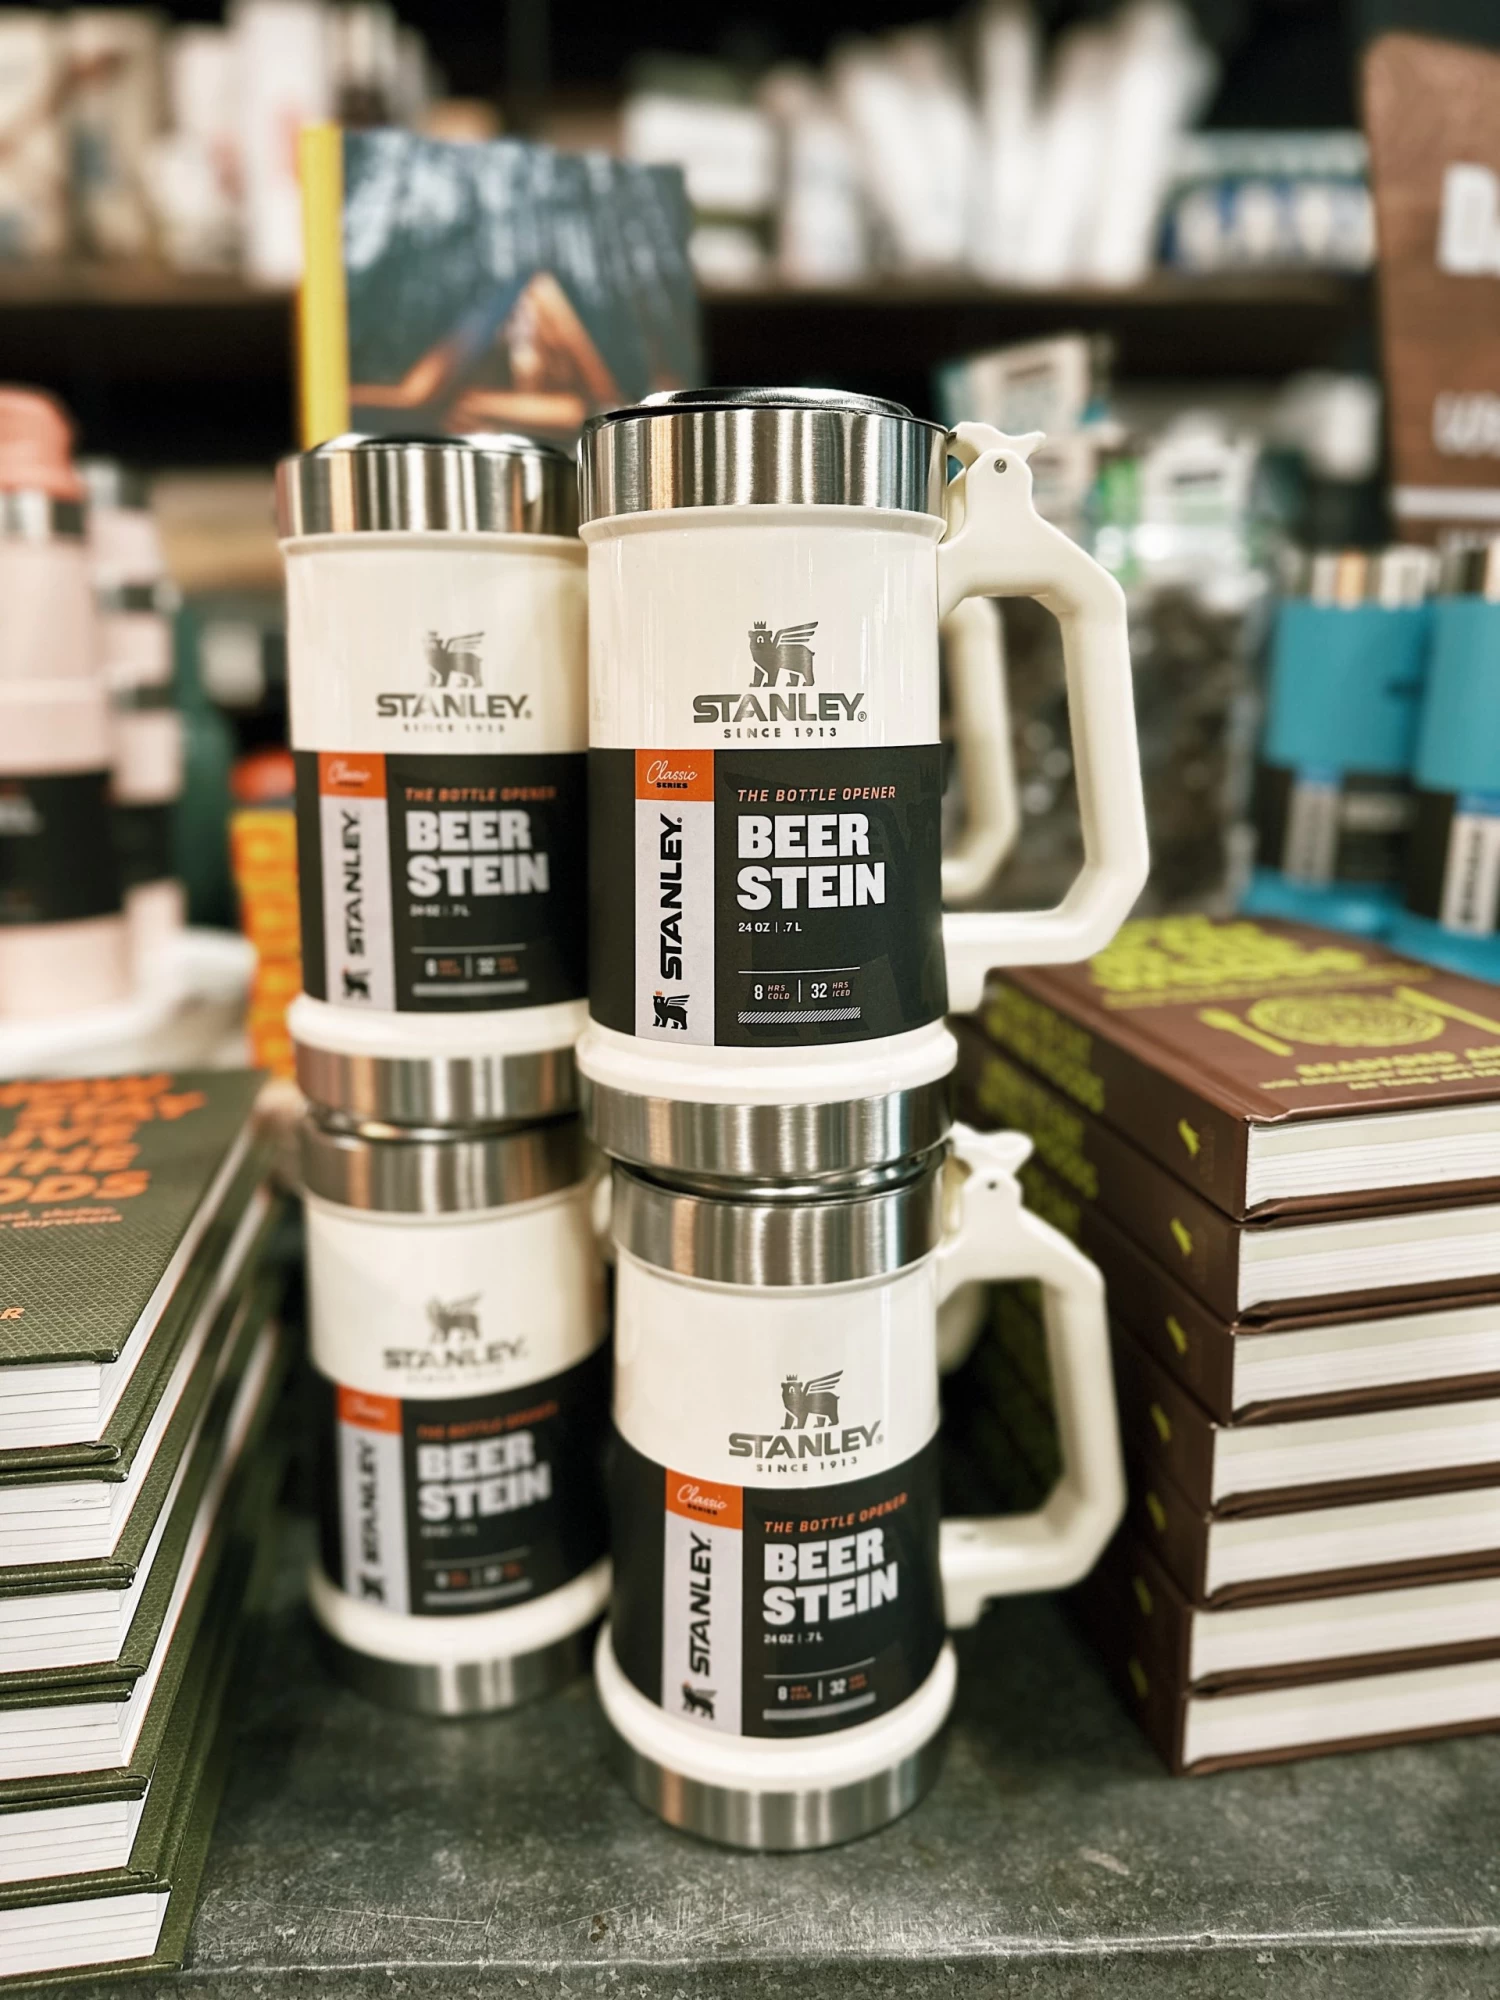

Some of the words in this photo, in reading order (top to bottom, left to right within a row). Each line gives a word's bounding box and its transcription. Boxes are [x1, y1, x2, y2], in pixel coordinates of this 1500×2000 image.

[376, 694, 529, 719] STANLEY
[724, 727, 783, 739] SINCE
[794, 726, 838, 739] 1913
[646, 760, 698, 783] Classic
[405, 787, 434, 802] THE
[737, 788, 769, 803] THE
[775, 787, 837, 802] BOTTLE
[842, 786, 896, 801] OPENER
[405, 810, 532, 852] BEER
[737, 813, 870, 860] BEER
[342, 811, 365, 957] STANLEY
[406, 852, 550, 898] STEIN
[736, 861, 886, 911] STEIN
[737, 921, 753, 934] 24
[754, 921, 771, 934] OZ
[782, 921, 793, 933] .7
[794, 920, 803, 933] L
[753, 983, 764, 1001] 8
[810, 982, 828, 999] 32
[767, 984, 786, 993] HRS
[832, 980, 849, 989] HRS
[767, 992, 790, 1001] COLD
[832, 988, 851, 997] ICED
[416, 1431, 535, 1483] BEER
[756, 1463, 809, 1474] SINCE
[819, 1456, 859, 1471] 1913
[418, 1462, 552, 1521] STEIN
[764, 1520, 793, 1534] THE
[799, 1513, 855, 1534] BOTTLE
[763, 1527, 885, 1583] BEER
[762, 1562, 898, 1626] STEIN
[763, 1633, 777, 1645] 24
